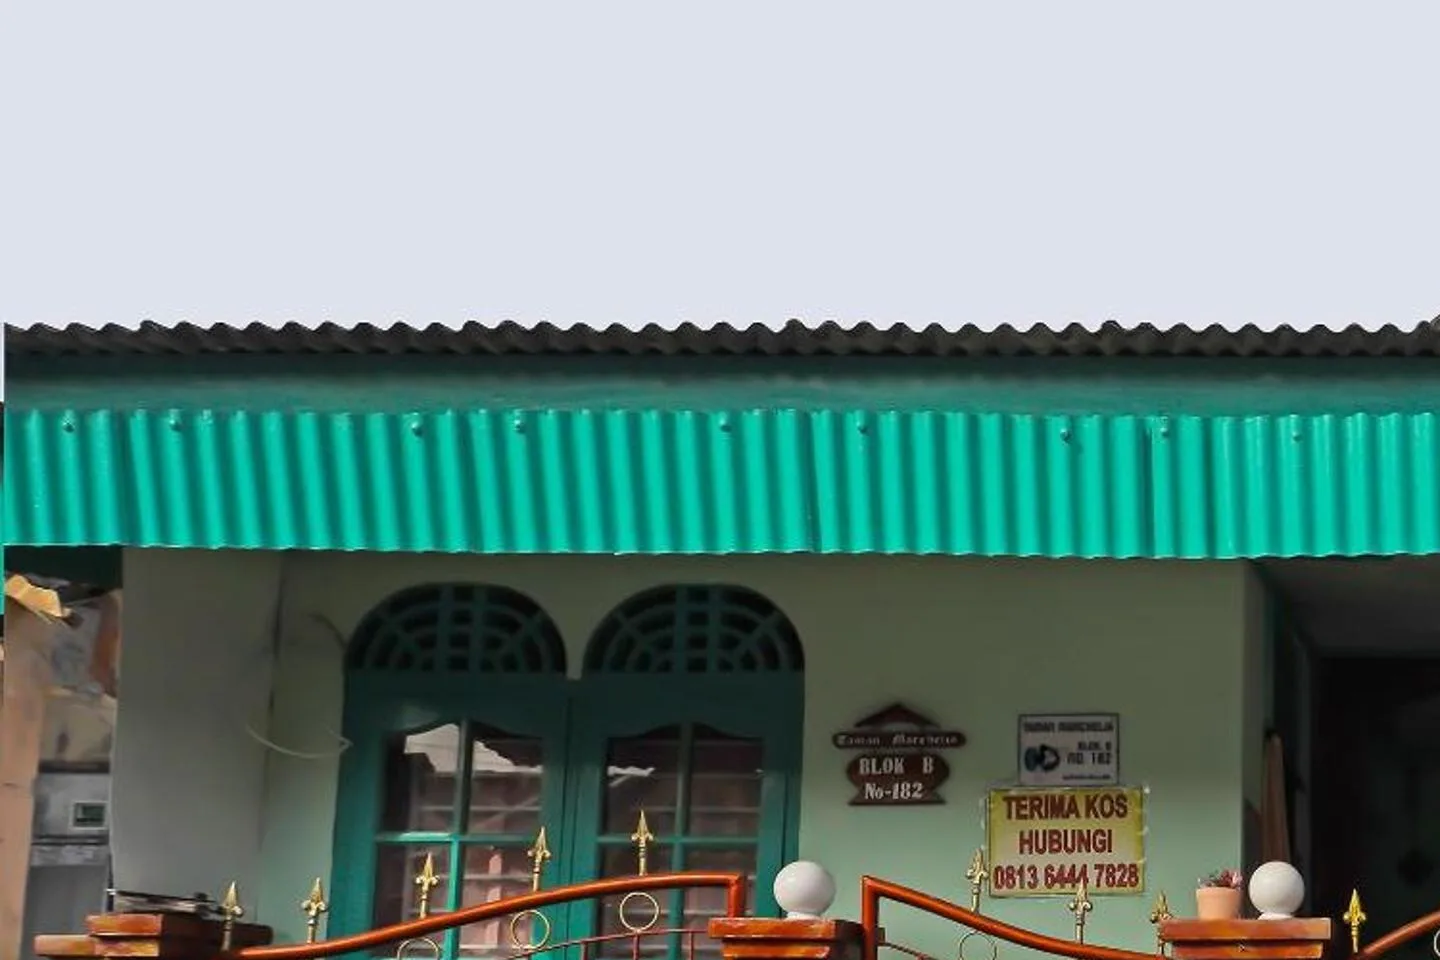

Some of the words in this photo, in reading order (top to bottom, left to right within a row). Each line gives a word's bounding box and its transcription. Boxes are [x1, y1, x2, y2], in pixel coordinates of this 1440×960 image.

[859, 757, 905, 775] BLOK
[922, 756, 935, 774] B
[1003, 794, 1080, 820] TERIMA
[1084, 793, 1128, 819] KOS
[1019, 828, 1113, 855] HUBUNGI
[993, 864, 1039, 889] 0813
[1043, 863, 1089, 888] 6444
[1093, 863, 1139, 888] 7828
